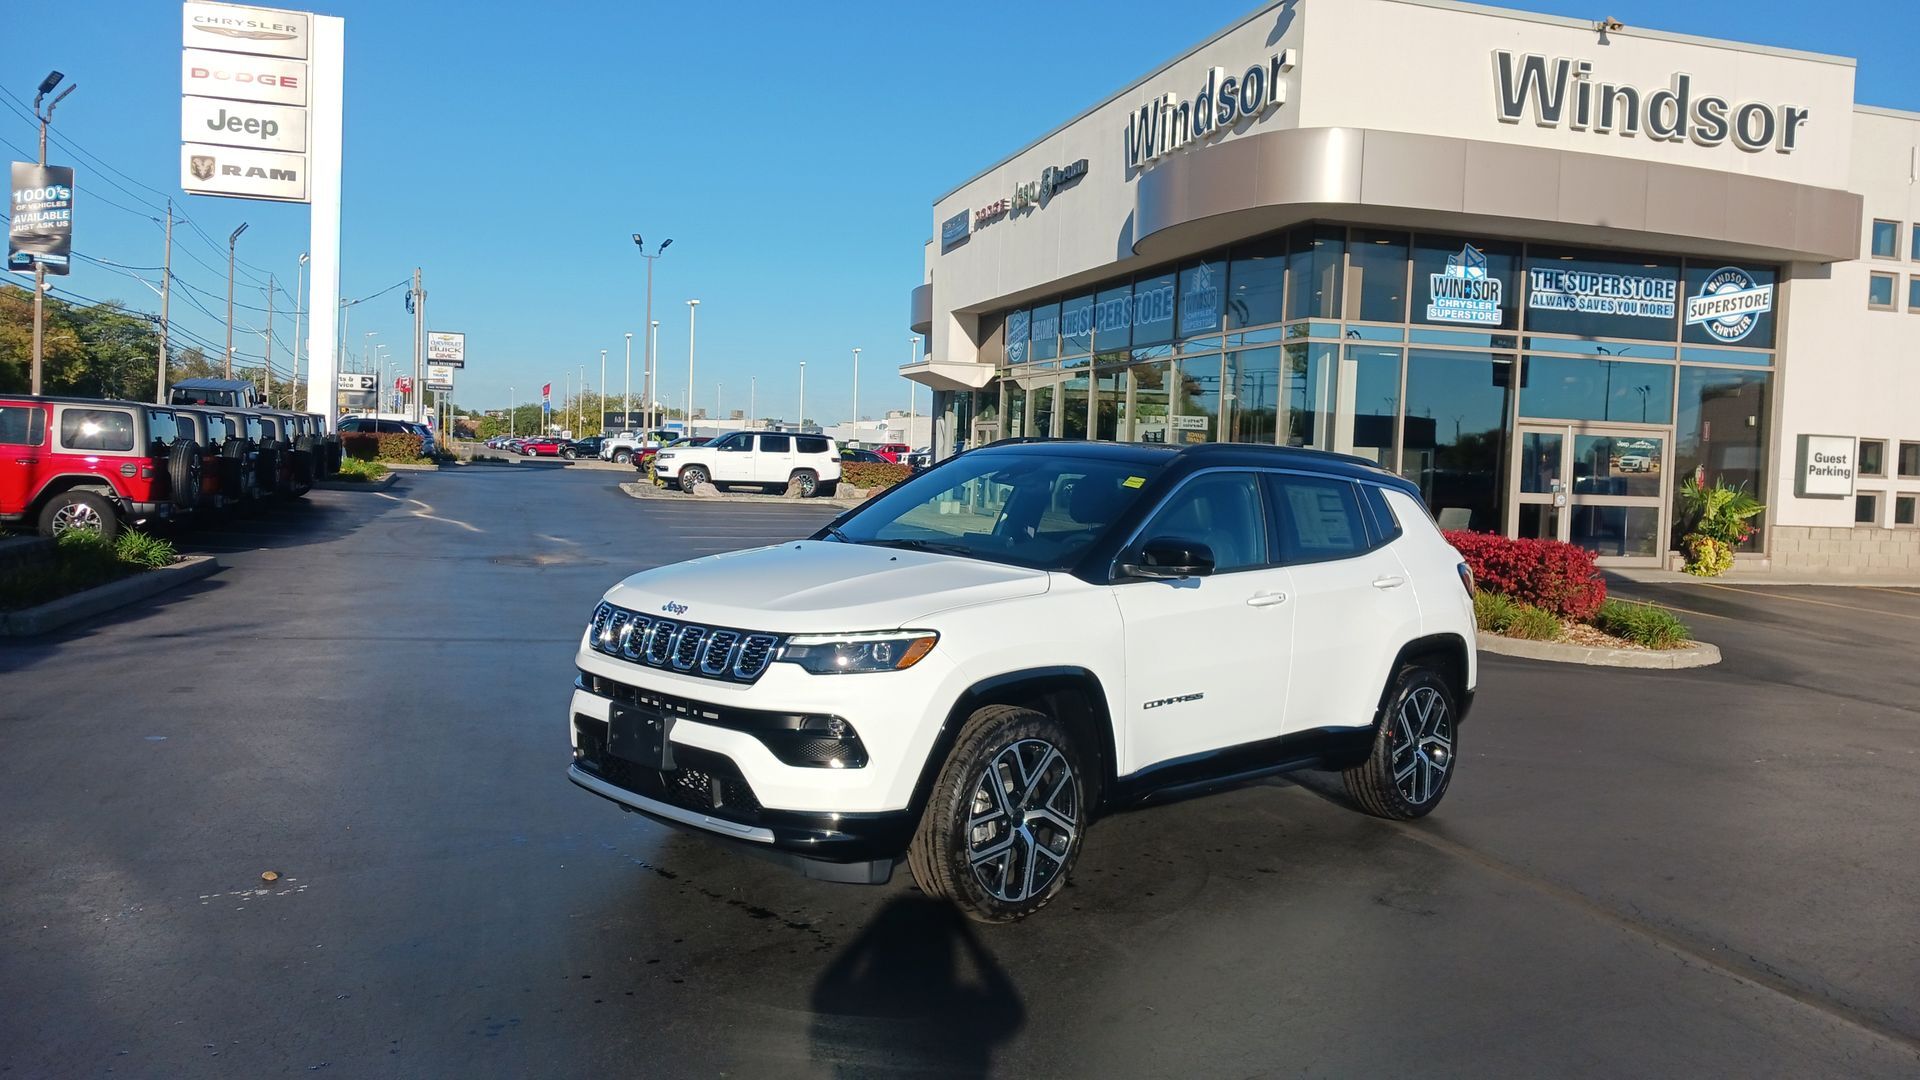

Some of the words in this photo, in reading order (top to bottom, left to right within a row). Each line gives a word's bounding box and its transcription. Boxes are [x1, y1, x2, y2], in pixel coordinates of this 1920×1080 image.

[193, 15, 297, 32] CHRYSLER
[191, 67, 298, 88] DODGE
[1126, 48, 1297, 168] Windsor
[1491, 48, 1809, 154] Windsor
[206, 108, 279, 140] Jeep
[221, 164, 297, 181] RAM
[14, 186, 70, 204] 1000's
[28, 201, 67, 210] VEHICLES
[13, 210, 70, 225] AVAILABLE
[13, 223, 34, 232] JUST
[36, 221, 54, 229] ASK
[1433, 276, 1500, 301] WINDSOR
[1531, 270, 1565, 290] THE
[1566, 272, 1675, 300] SUPERSTORE
[1707, 272, 1748, 293] WINDSOR
[1078, 287, 1174, 337] SUPERSTORE
[1438, 299, 1492, 310] CHRYSLER
[1531, 293, 1576, 309] ALWAYS
[1578, 298, 1615, 312] SAVES
[1616, 301, 1638, 314] YOU
[1639, 302, 1674, 317] MORE!
[1690, 292, 1769, 318] SUPERSTORE
[1430, 308, 1500, 321] SUPERSTORE
[1712, 315, 1752, 337] CHRYSLER
[1814, 452, 1847, 464] Guest
[1808, 464, 1851, 479] Parking
[661, 600, 689, 615] Jeep
[1143, 692, 1204, 709] COMPASS
